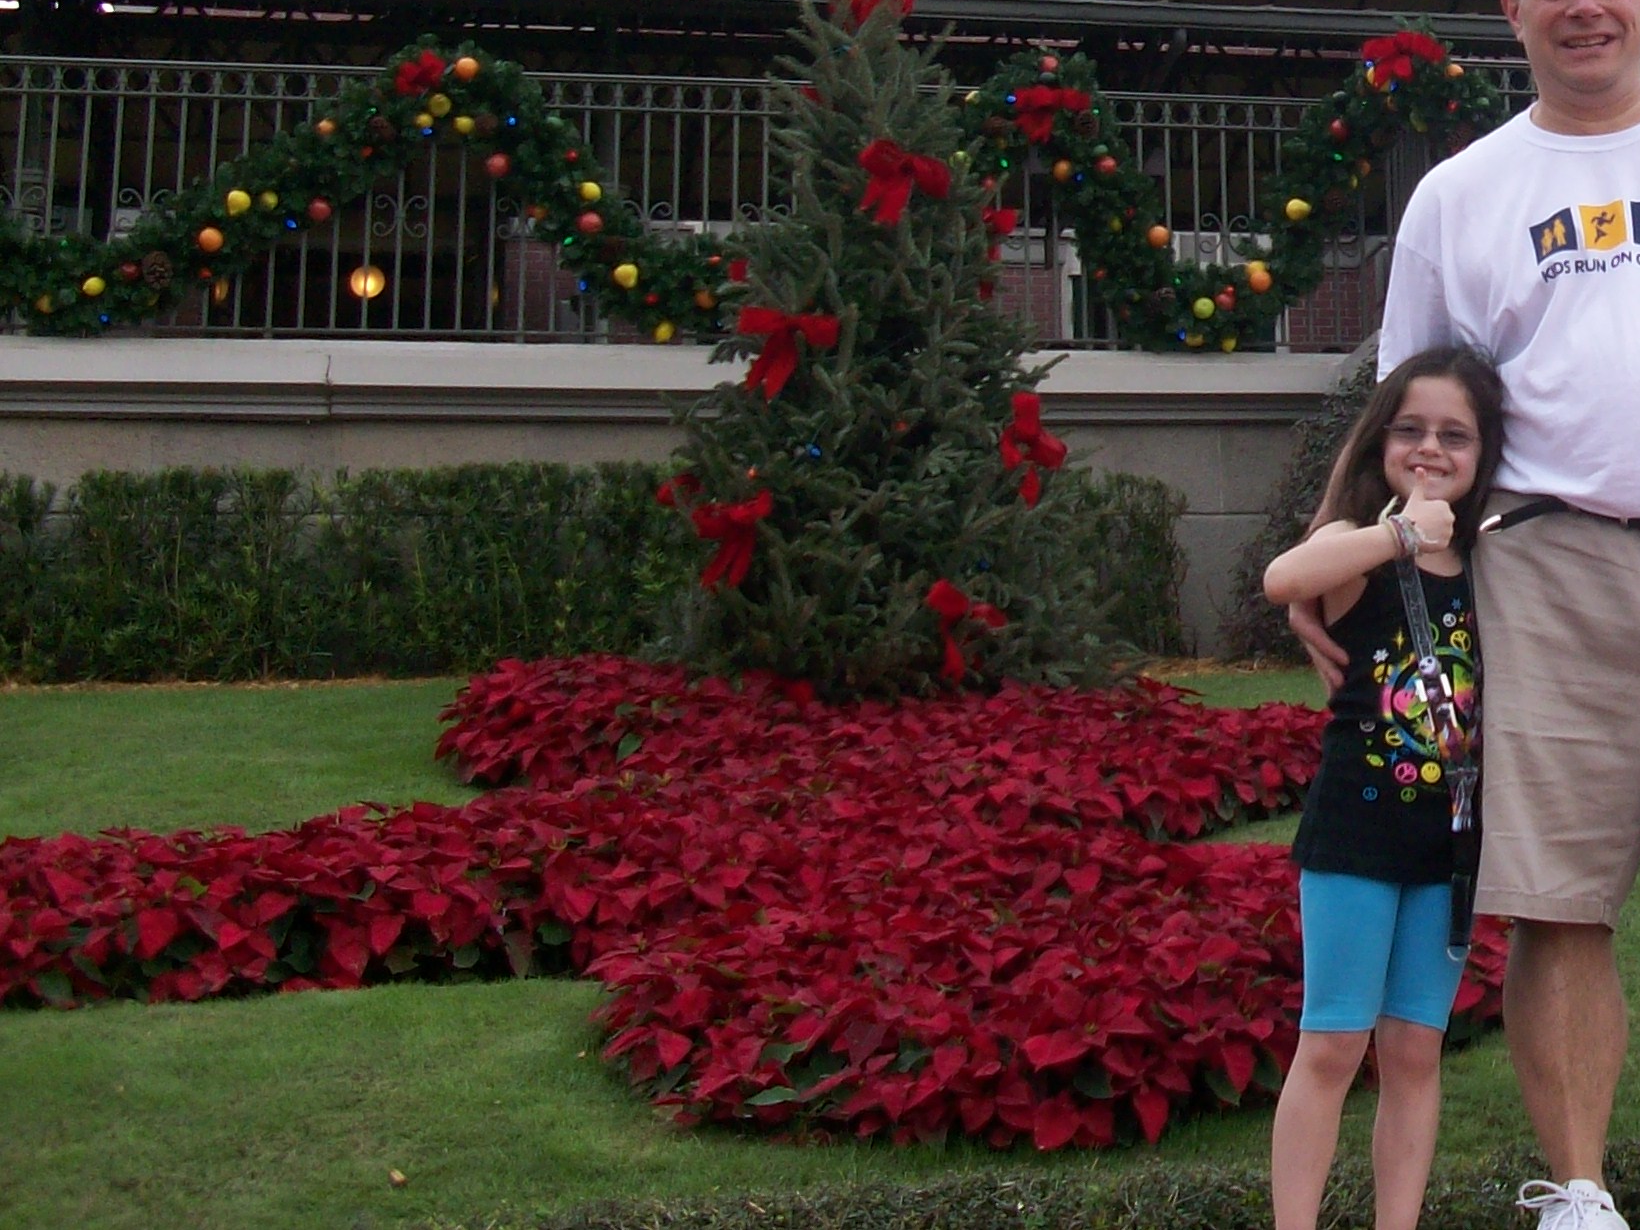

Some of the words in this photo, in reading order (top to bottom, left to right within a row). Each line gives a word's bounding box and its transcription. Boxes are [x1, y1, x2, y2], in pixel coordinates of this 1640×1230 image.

[1541, 260, 1571, 283] KIDS
[1574, 258, 1606, 274] RUN
[1611, 251, 1632, 269] ON
